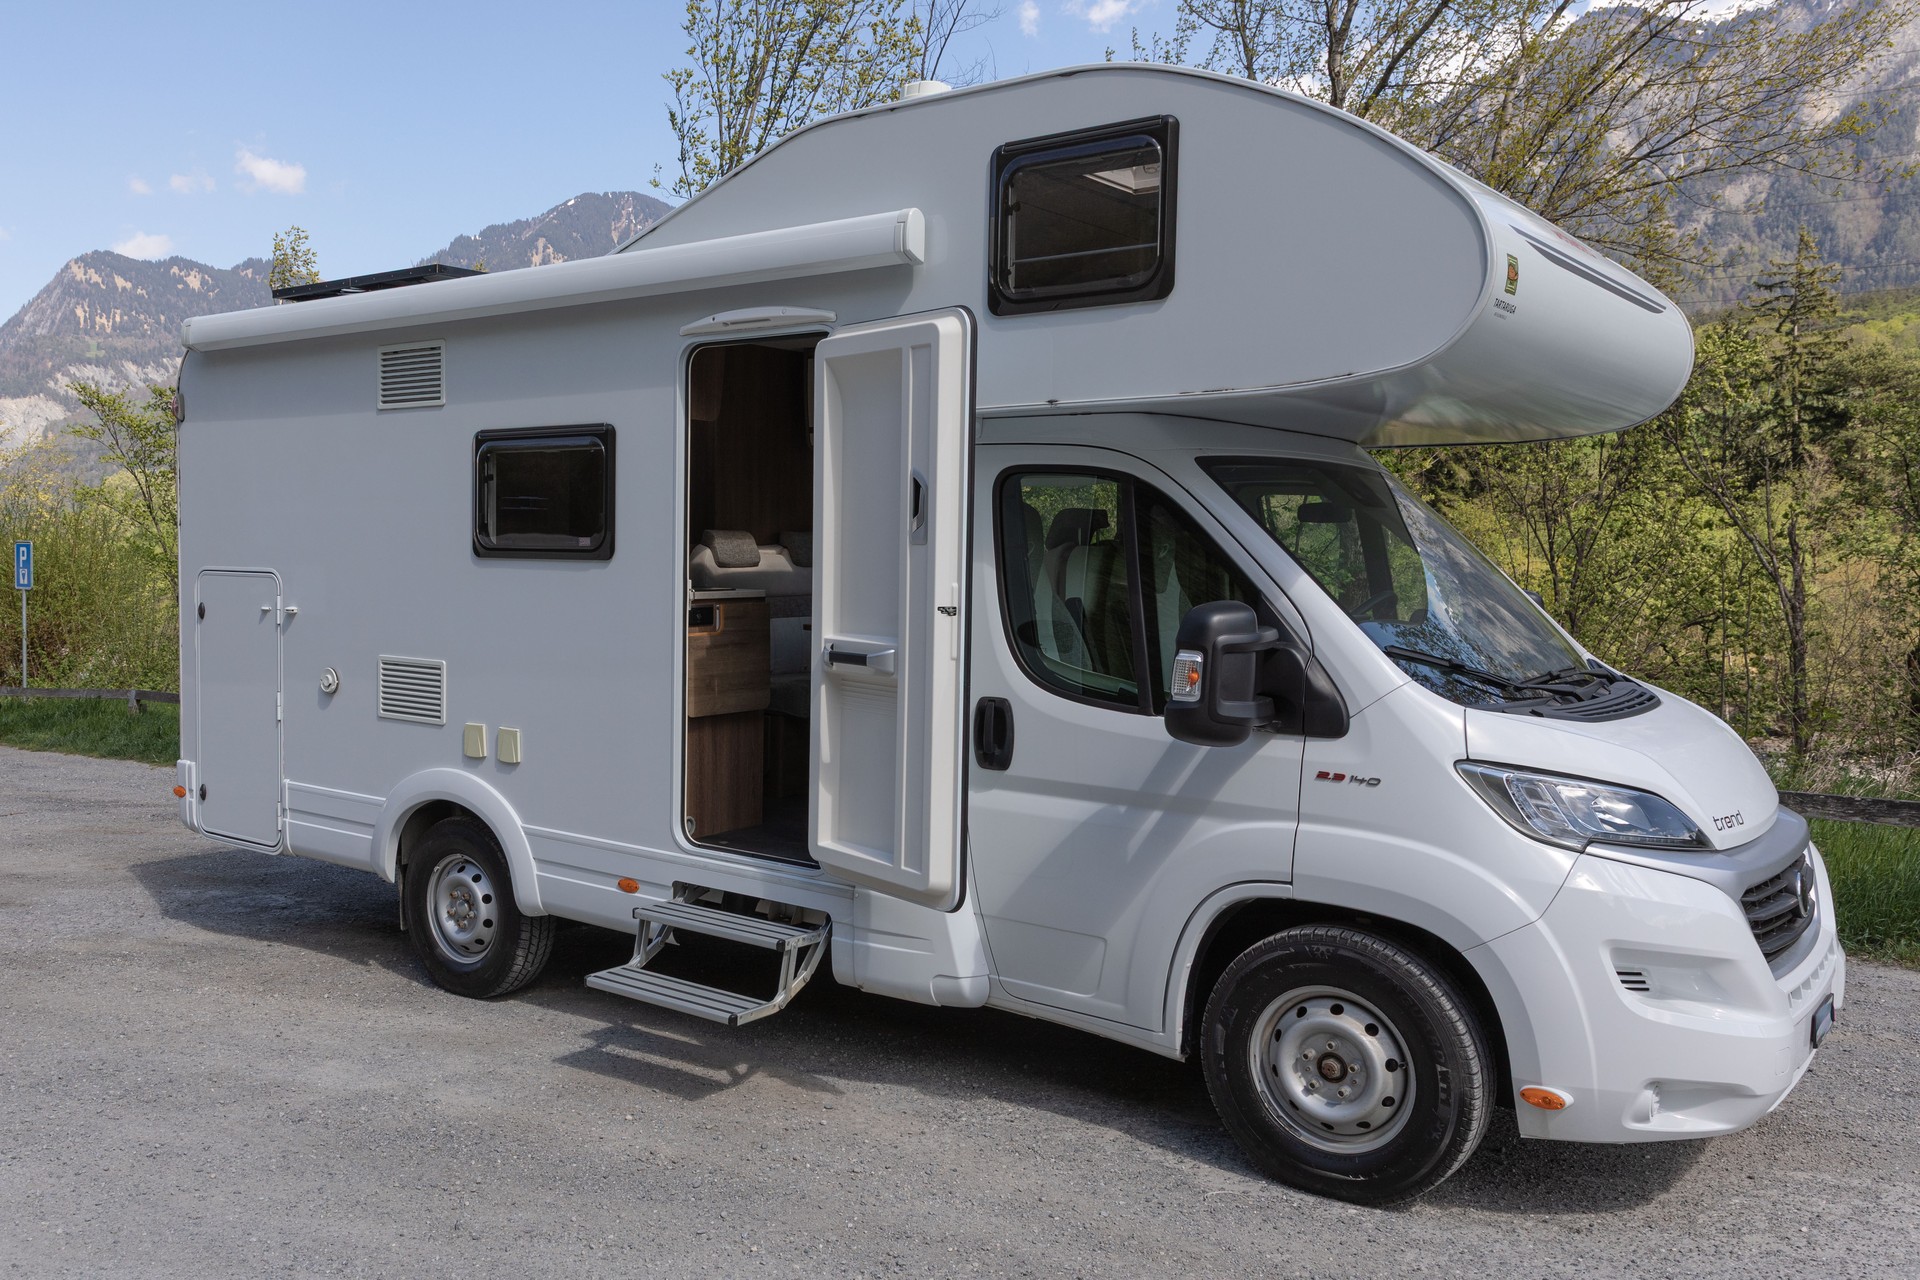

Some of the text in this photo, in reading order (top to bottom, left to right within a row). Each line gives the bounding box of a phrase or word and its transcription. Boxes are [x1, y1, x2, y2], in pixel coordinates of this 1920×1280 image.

[1493, 298, 1517, 314] TARTARUGA
[20, 546, 27, 568] P
[1315, 770, 1382, 787] 2.3 140
[1712, 809, 1745, 832] trend
